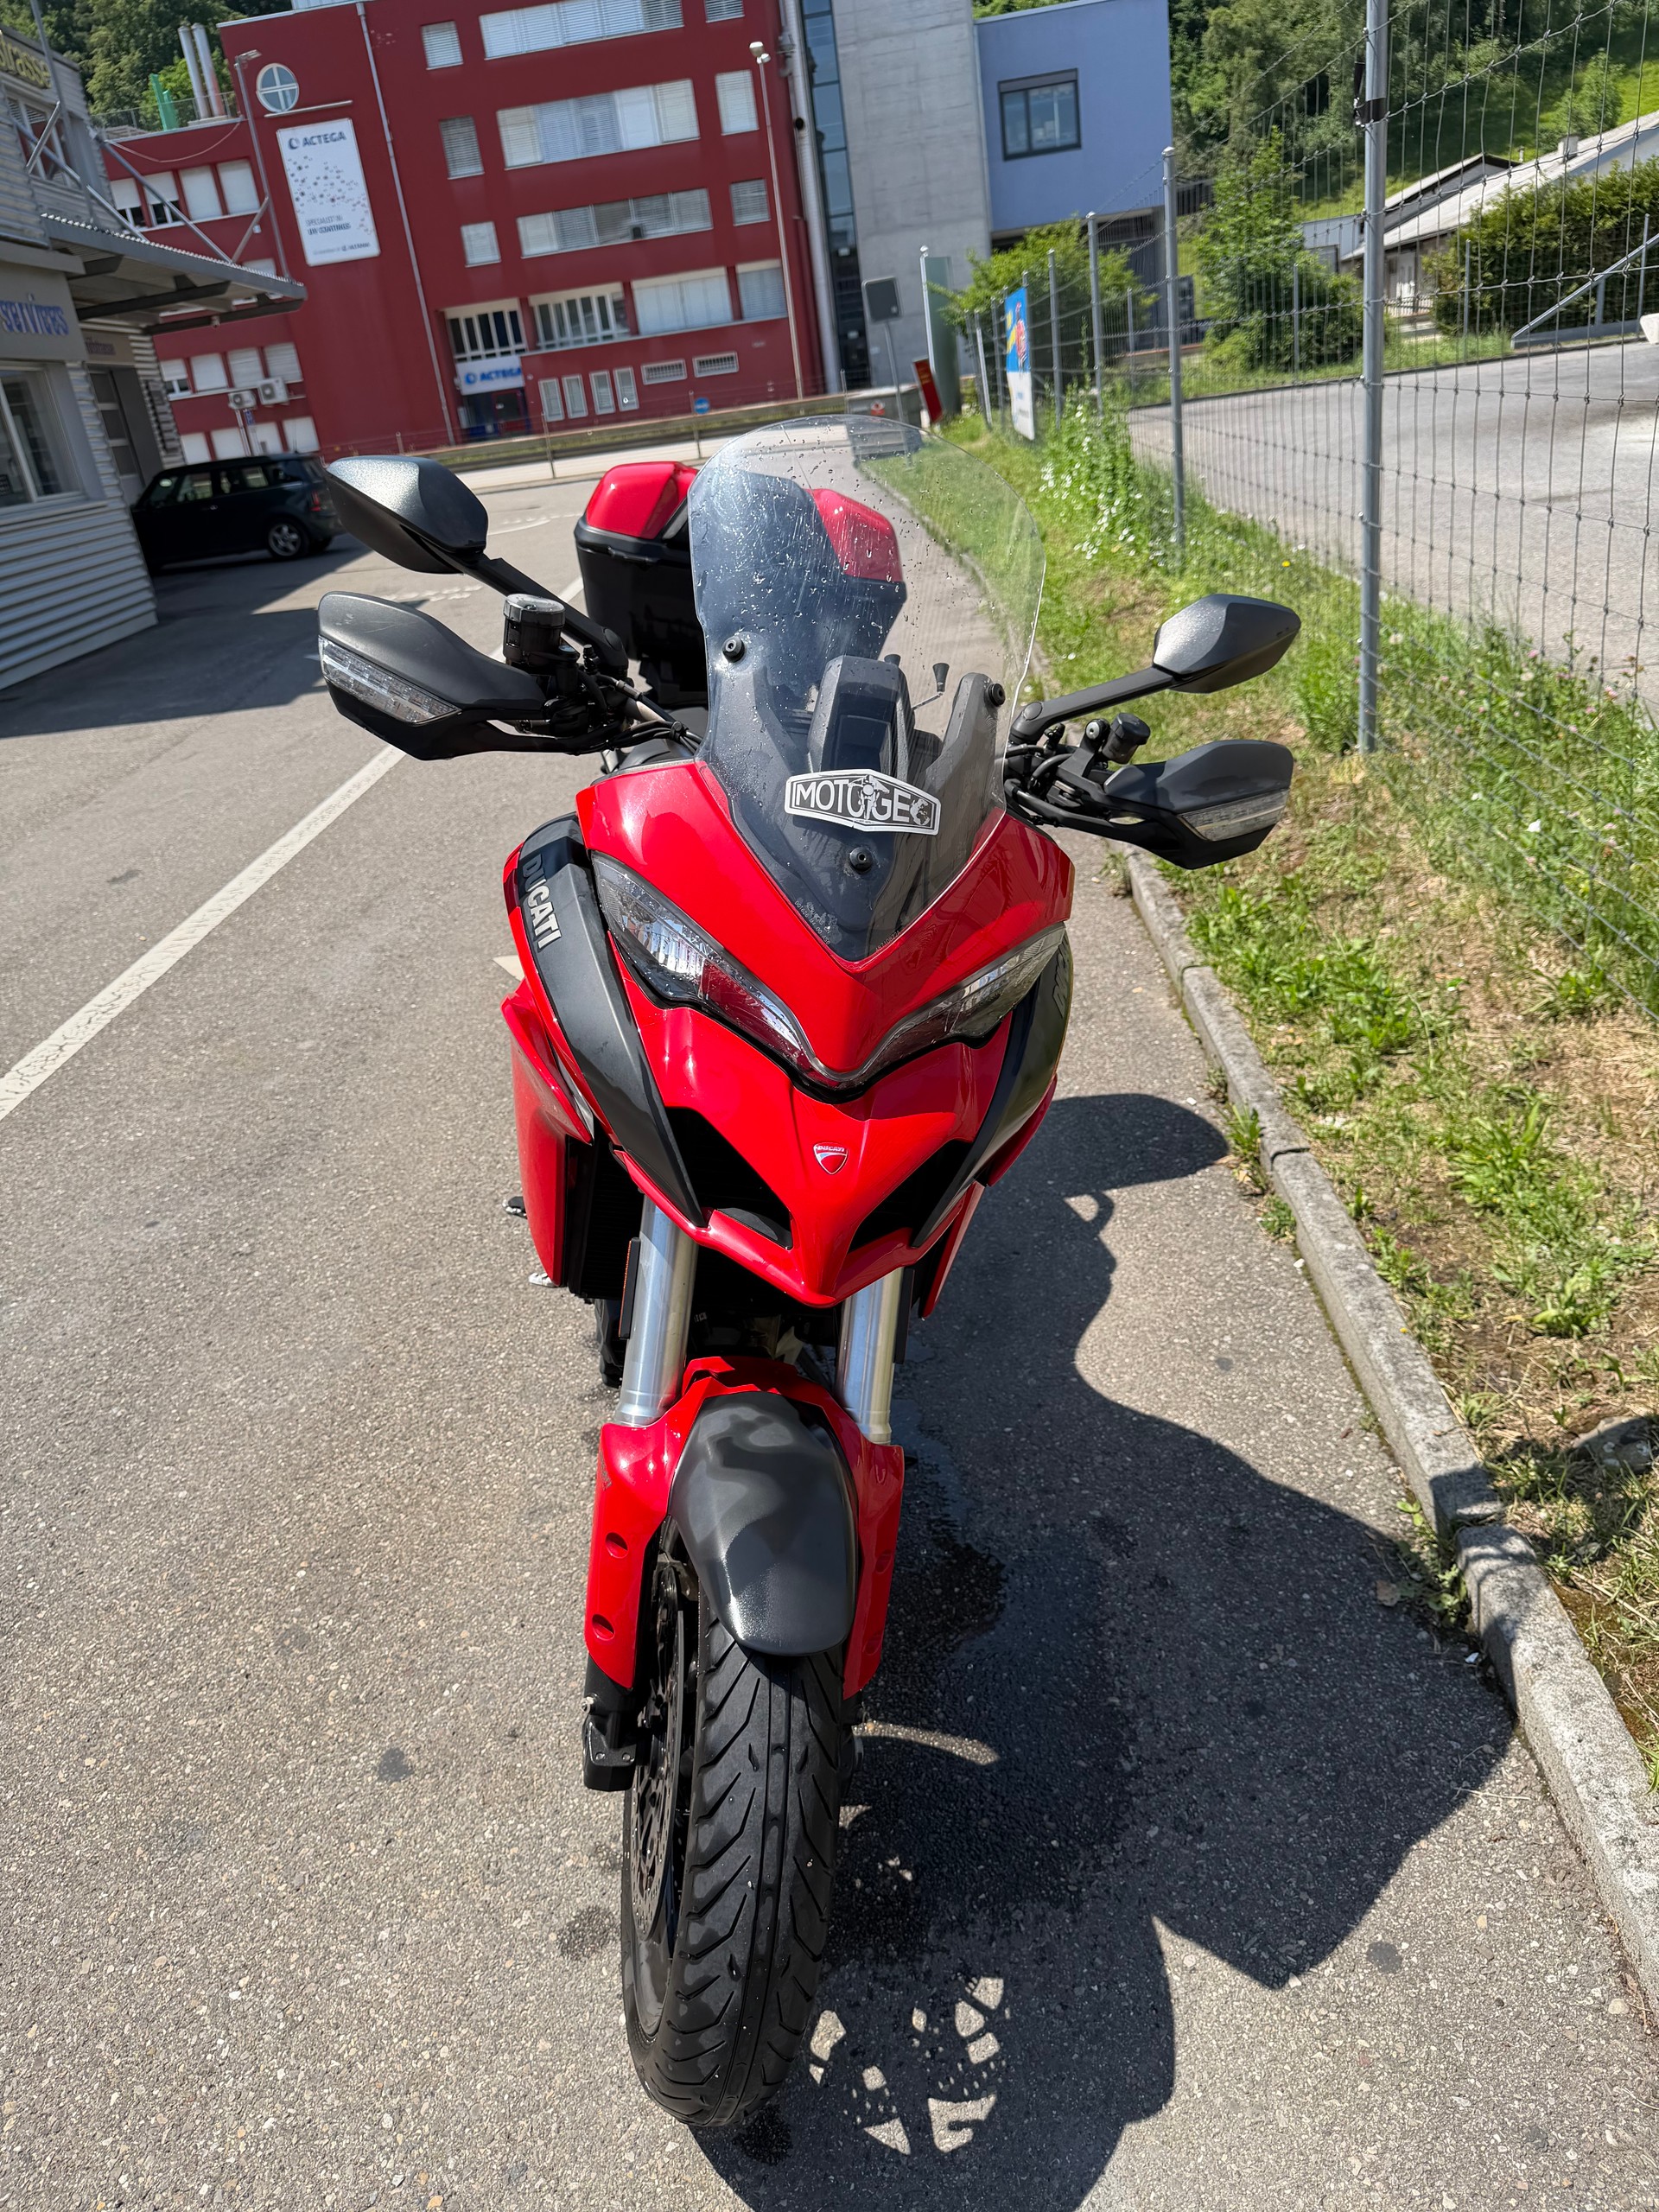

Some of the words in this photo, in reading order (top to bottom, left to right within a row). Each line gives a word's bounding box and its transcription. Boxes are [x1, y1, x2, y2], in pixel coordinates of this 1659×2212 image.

[303, 131, 346, 147] ACTEGA
[480, 367, 522, 382] ACTEGA
[522, 853, 563, 950] DUCATI
